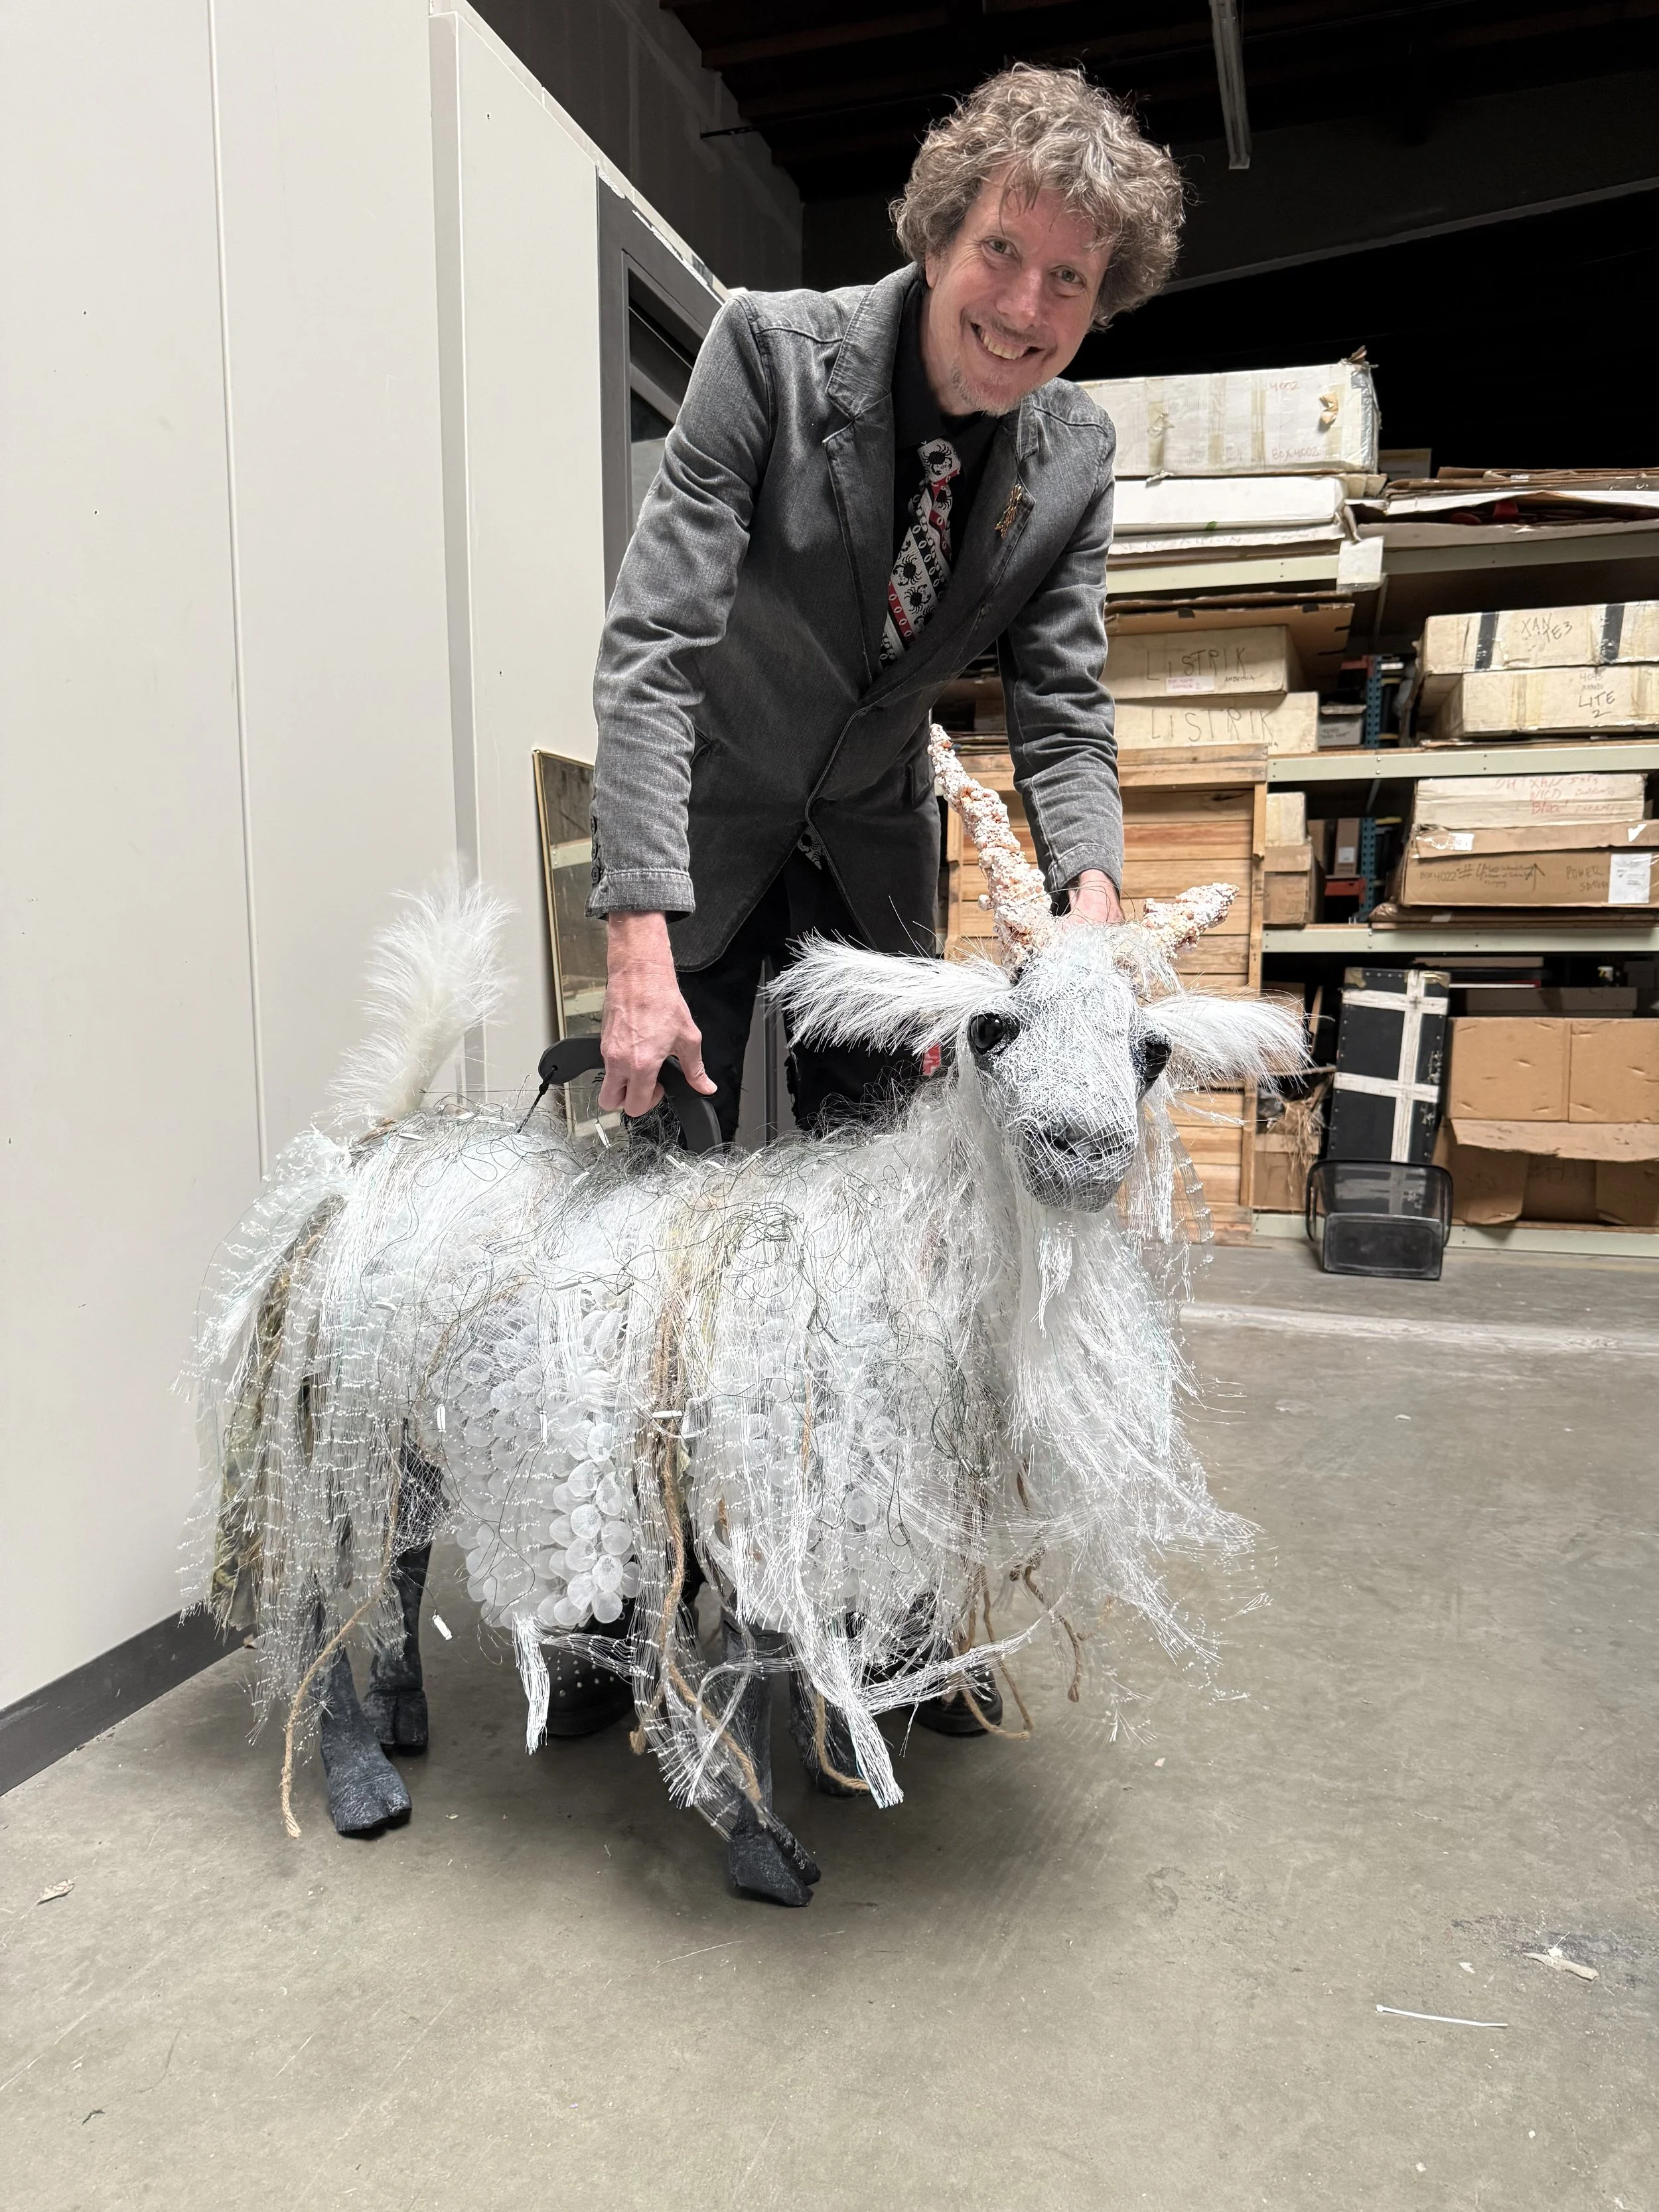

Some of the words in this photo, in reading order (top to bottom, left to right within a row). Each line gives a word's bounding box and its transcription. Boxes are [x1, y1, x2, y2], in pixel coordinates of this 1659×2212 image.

[1146, 646, 1246, 682] LISTRIK
[1579, 691, 1616, 709] LITE
[1592, 709, 1613, 719] 2
[1151, 706, 1274, 743] LISTRIK
[1566, 865, 1604, 881] POWER
